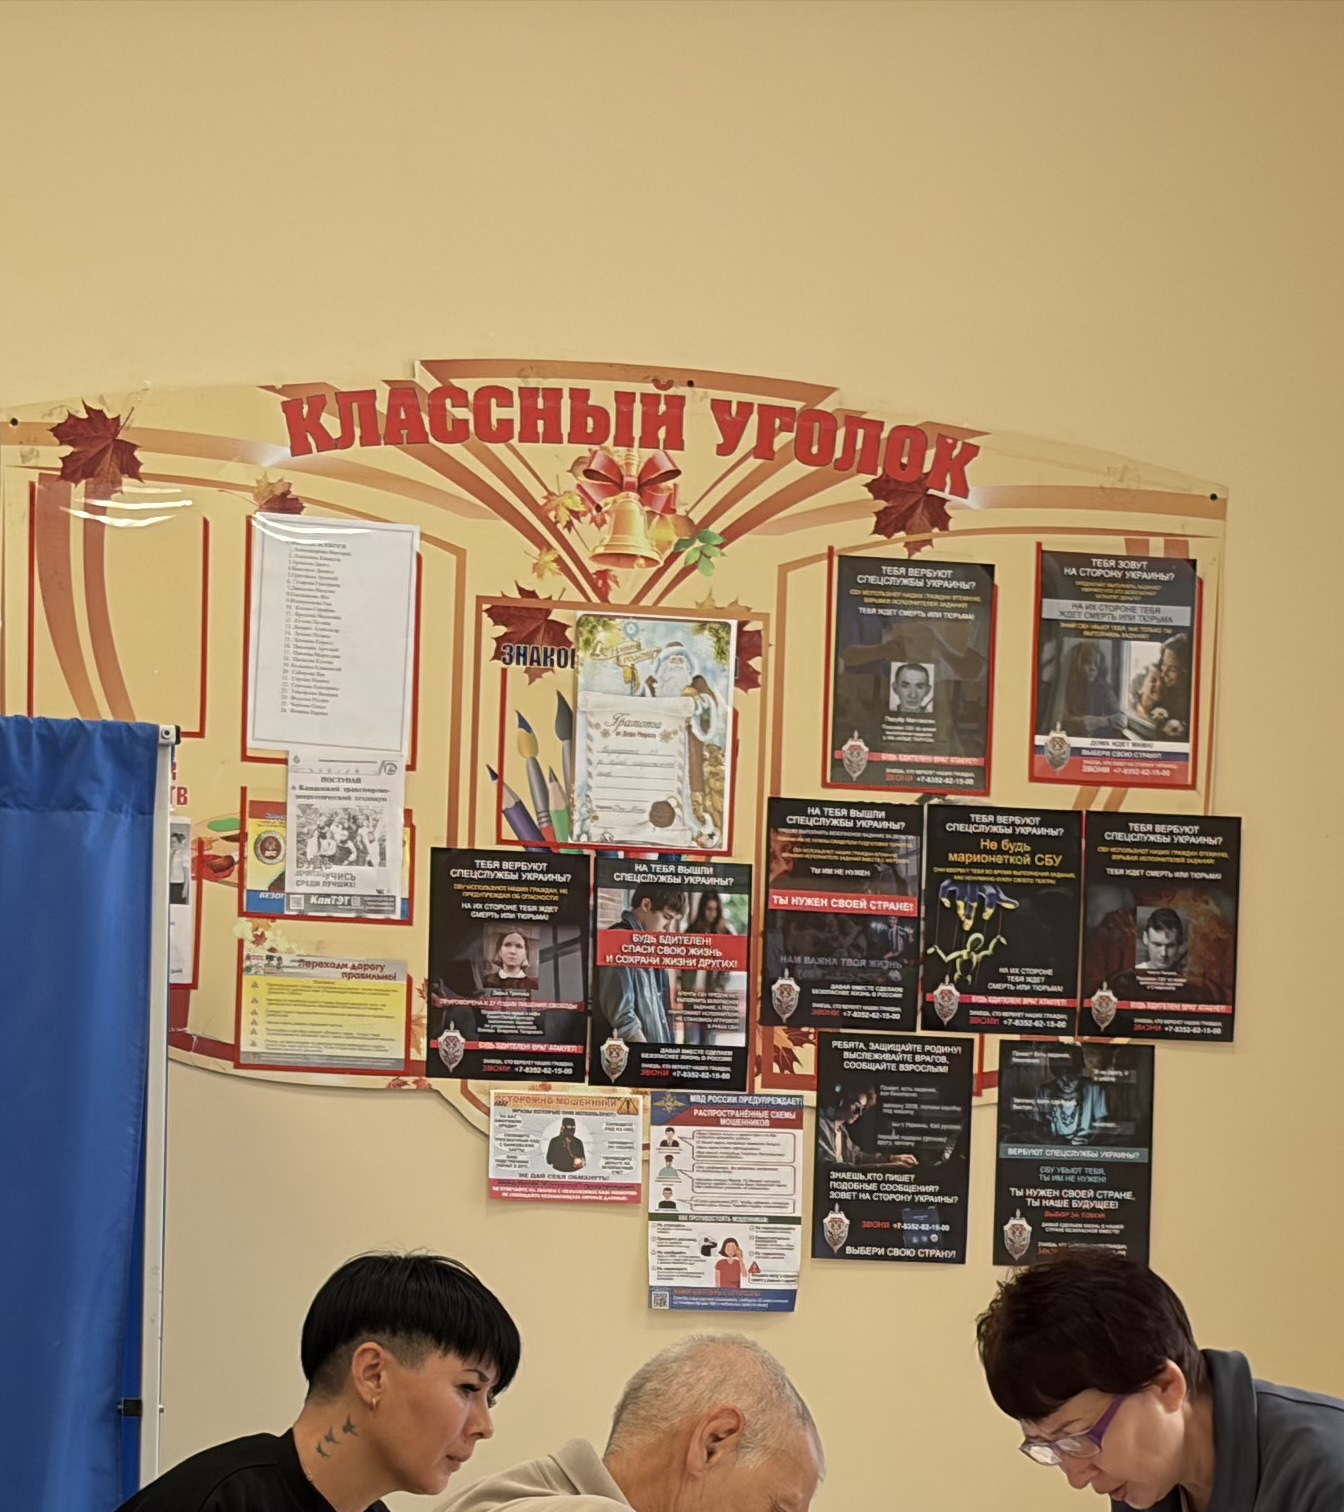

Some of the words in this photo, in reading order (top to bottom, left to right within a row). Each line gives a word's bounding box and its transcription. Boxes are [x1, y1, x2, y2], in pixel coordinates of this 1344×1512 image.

[282, 380, 685, 457] КЛАССНЫЙ
[710, 398, 980, 499] УГОЛОК
[1091, 558, 1117, 569] ТЕБЯ
[1118, 560, 1148, 569] ЗОВУТ
[881, 566, 906, 576] ТЕБЯ
[908, 568, 953, 578] ВЕРБУЮТ
[1064, 568, 1078, 576] НА
[1079, 568, 1123, 578] СТОРОНУ
[1125, 571, 1175, 581] УКРАИНЫ?
[857, 575, 924, 587] СПЕЦСЛУЖБЫ
[926, 579, 976, 590] УКРАИНЫ?
[807, 807, 821, 815] НА
[823, 808, 848, 816] ТЕБЯ
[850, 809, 885, 818] ВЫШЛИ
[786, 816, 853, 827] СПЕЦСЛУЖБЫ
[856, 820, 905, 830] УКРАИНЫ?
[970, 814, 994, 823] ТЕБЯ
[997, 815, 1041, 825] ВЕРБУЮТ
[946, 823, 1012, 834] СПЕЦСЛУЖБЫ
[1014, 826, 1064, 836] УКРАИНЫ?
[1128, 823, 1153, 832] ТЕБЯ
[1155, 824, 1199, 833] ВЕРБУЮТ
[1104, 832, 1171, 843] СПЕЦСЛУЖБЫ
[1173, 835, 1223, 845] УКРАИНЫ?
[980, 839, 998, 850] Не
[1001, 839, 1031, 853] будь
[475, 860, 500, 869] ТЕБЯ
[502, 861, 548, 871] ВЕРБУЮТ
[948, 853, 1031, 865] марионеткой
[1035, 854, 1062, 866] СБУ
[450, 869, 519, 880] СПЕЦСЛУЖБЫ
[521, 872, 571, 882] УКРАИНЫ?
[635, 864, 648, 872] НА
[650, 864, 675, 873] ТЕБЯ
[677, 866, 713, 875] ВЫШЛИ
[614, 872, 681, 884] СПЕЦСЛУЖБЫ
[684, 876, 734, 886] УКРАИНЫ?
[773, 895, 788, 904] ТЫ
[791, 897, 828, 906] НУЖЕН
[831, 898, 867, 909] СВОЕЙ
[869, 901, 913, 911] СТРАНЕ!
[633, 934, 656, 943] БУДЬ
[659, 935, 711, 946] БДИТЕЛЕН!
[622, 944, 655, 954] СПАСИ
[658, 946, 686, 955] СВОЮ
[688, 947, 722, 956] ЖИЗНЬ
[298, 959, 349, 971] Переходи
[350, 963, 385, 972] дорогу
[616, 956, 660, 965] СОХРАНИ
[662, 957, 696, 966] ЖИЗНИ
[698, 958, 737, 968] ДРУГИХ!
[342, 972, 396, 981] правильно!
[832, 1041, 866, 1050] РЕБЯТА,
[869, 1042, 922, 1053] ЗАЩИЩАЙТЕ
[843, 1051, 912, 1062] ВЫСЛЕЖИВАЙТЕ
[915, 1054, 949, 1064] ВРАГОВ,
[844, 1062, 897, 1071] СООБЩАЙТЕ
[899, 1064, 948, 1073] ВЗРОСЛЫМ!
[690, 1095, 706, 1103] МВД
[707, 1096, 737, 1104] РОССИИ
[738, 1096, 802, 1105] ПРЕДУПРЕЖДАЕТ!
[770, 1111, 796, 1119] СХЕМЫ
[720, 1118, 770, 1126] МОШЕННИКОВ
[1045, 1149, 1098, 1158] СПЕЦСЛУЖБЫ
[1100, 1151, 1139, 1159] УКРАИНЫ?
[885, 1174, 915, 1182] ПИШЕТ
[830, 1181, 878, 1191] ПОДОБНЫЕ
[880, 1183, 939, 1193] СООБЩЕНИЯ?
[829, 1191, 857, 1199] ЗОВЕТ
[859, 1192, 871, 1200] НА
[872, 1194, 912, 1202] СТОРОНУ
[914, 1195, 958, 1204] УКРАИНЫ?
[1009, 1187, 1024, 1196] ТЫ
[1026, 1188, 1059, 1197] НУЖЕН
[1062, 1189, 1094, 1198] СВОЕЙ
[1096, 1191, 1135, 1200] СТРАНЕ,
[1026, 1198, 1040, 1207] ТЫ
[1042, 1199, 1070, 1207] НАШЕ
[1072, 1200, 1118, 1210] БУДУЩЕЕ!
[846, 1246, 884, 1255] ВЫБЕРИ
[887, 1248, 915, 1257] СВОЮ
[918, 1250, 956, 1258] СТРАНУ!
